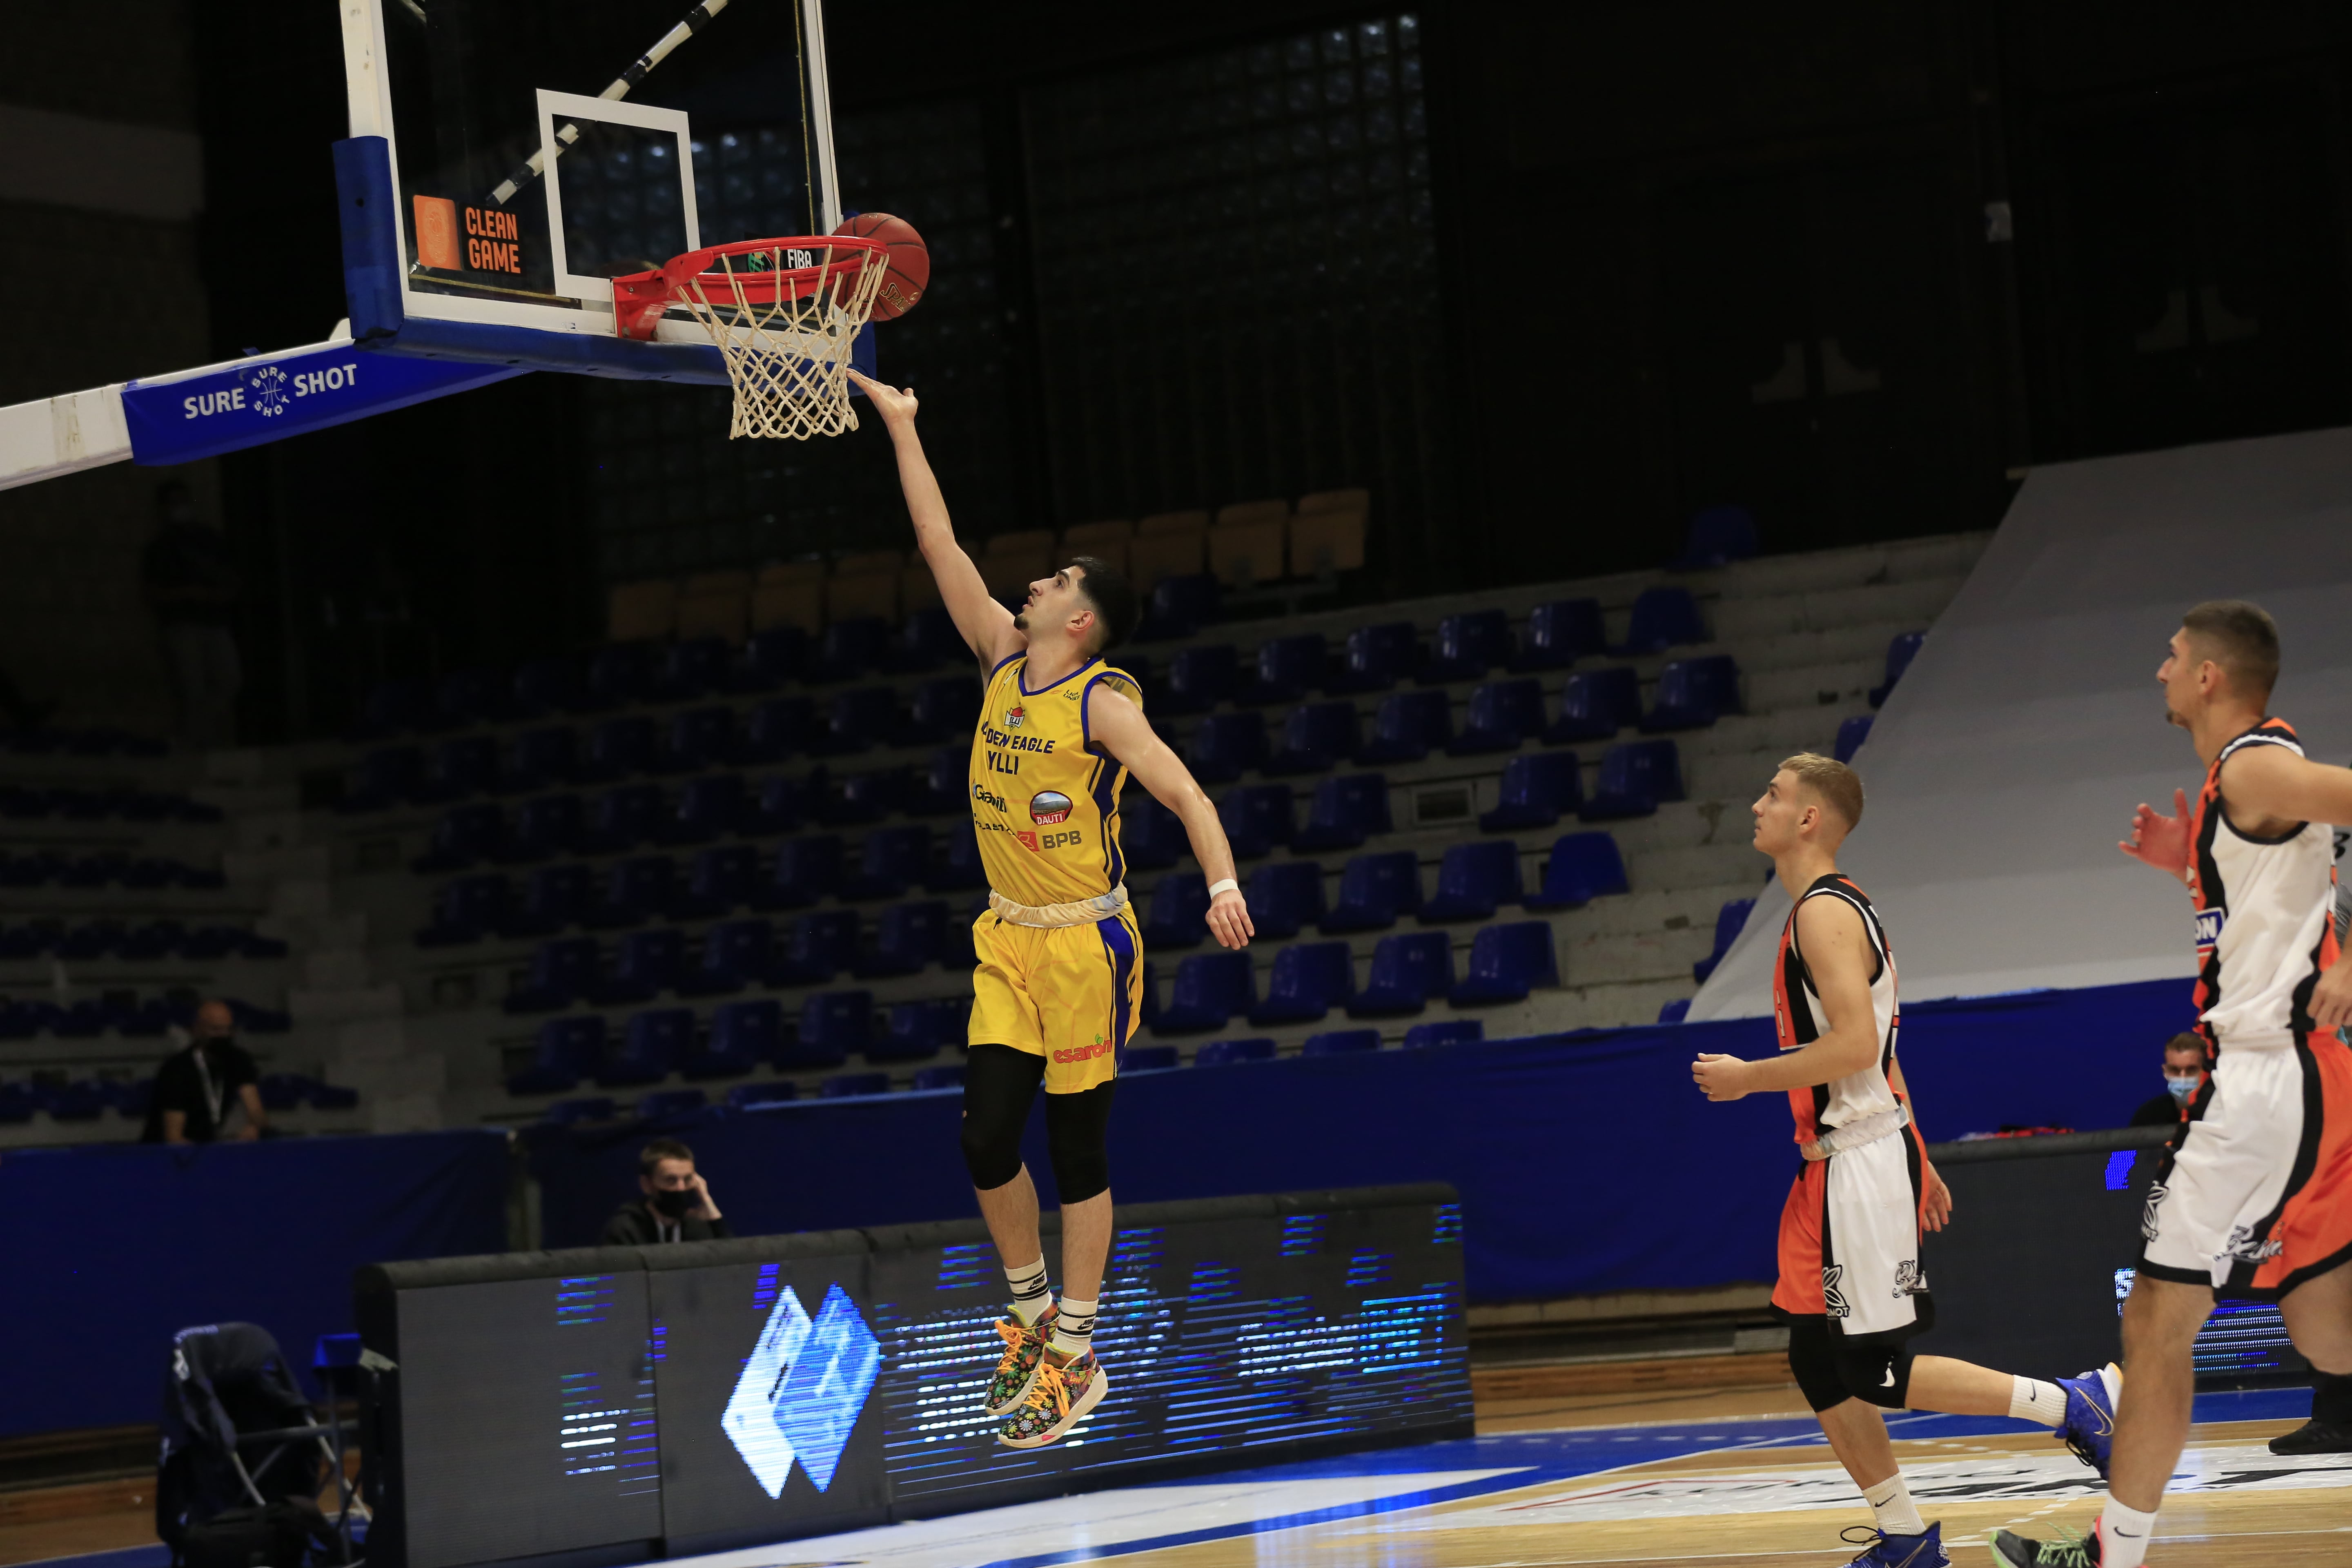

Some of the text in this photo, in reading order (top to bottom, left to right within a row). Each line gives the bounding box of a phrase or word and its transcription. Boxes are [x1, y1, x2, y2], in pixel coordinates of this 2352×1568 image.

[466, 207, 518, 241] CLEAN
[469, 238, 521, 274] GAME
[787, 249, 812, 270] FIBA
[251, 366, 287, 388] SURE
[184, 364, 357, 419] SURE SHOT
[254, 394, 290, 417] SHOT
[1011, 735, 1056, 754] EAGLE
[988, 750, 1019, 775] YLLI
[1036, 813, 1063, 826] DAUTI
[1042, 830, 1082, 849] BPB
[1053, 1040, 1112, 1064] esaron
